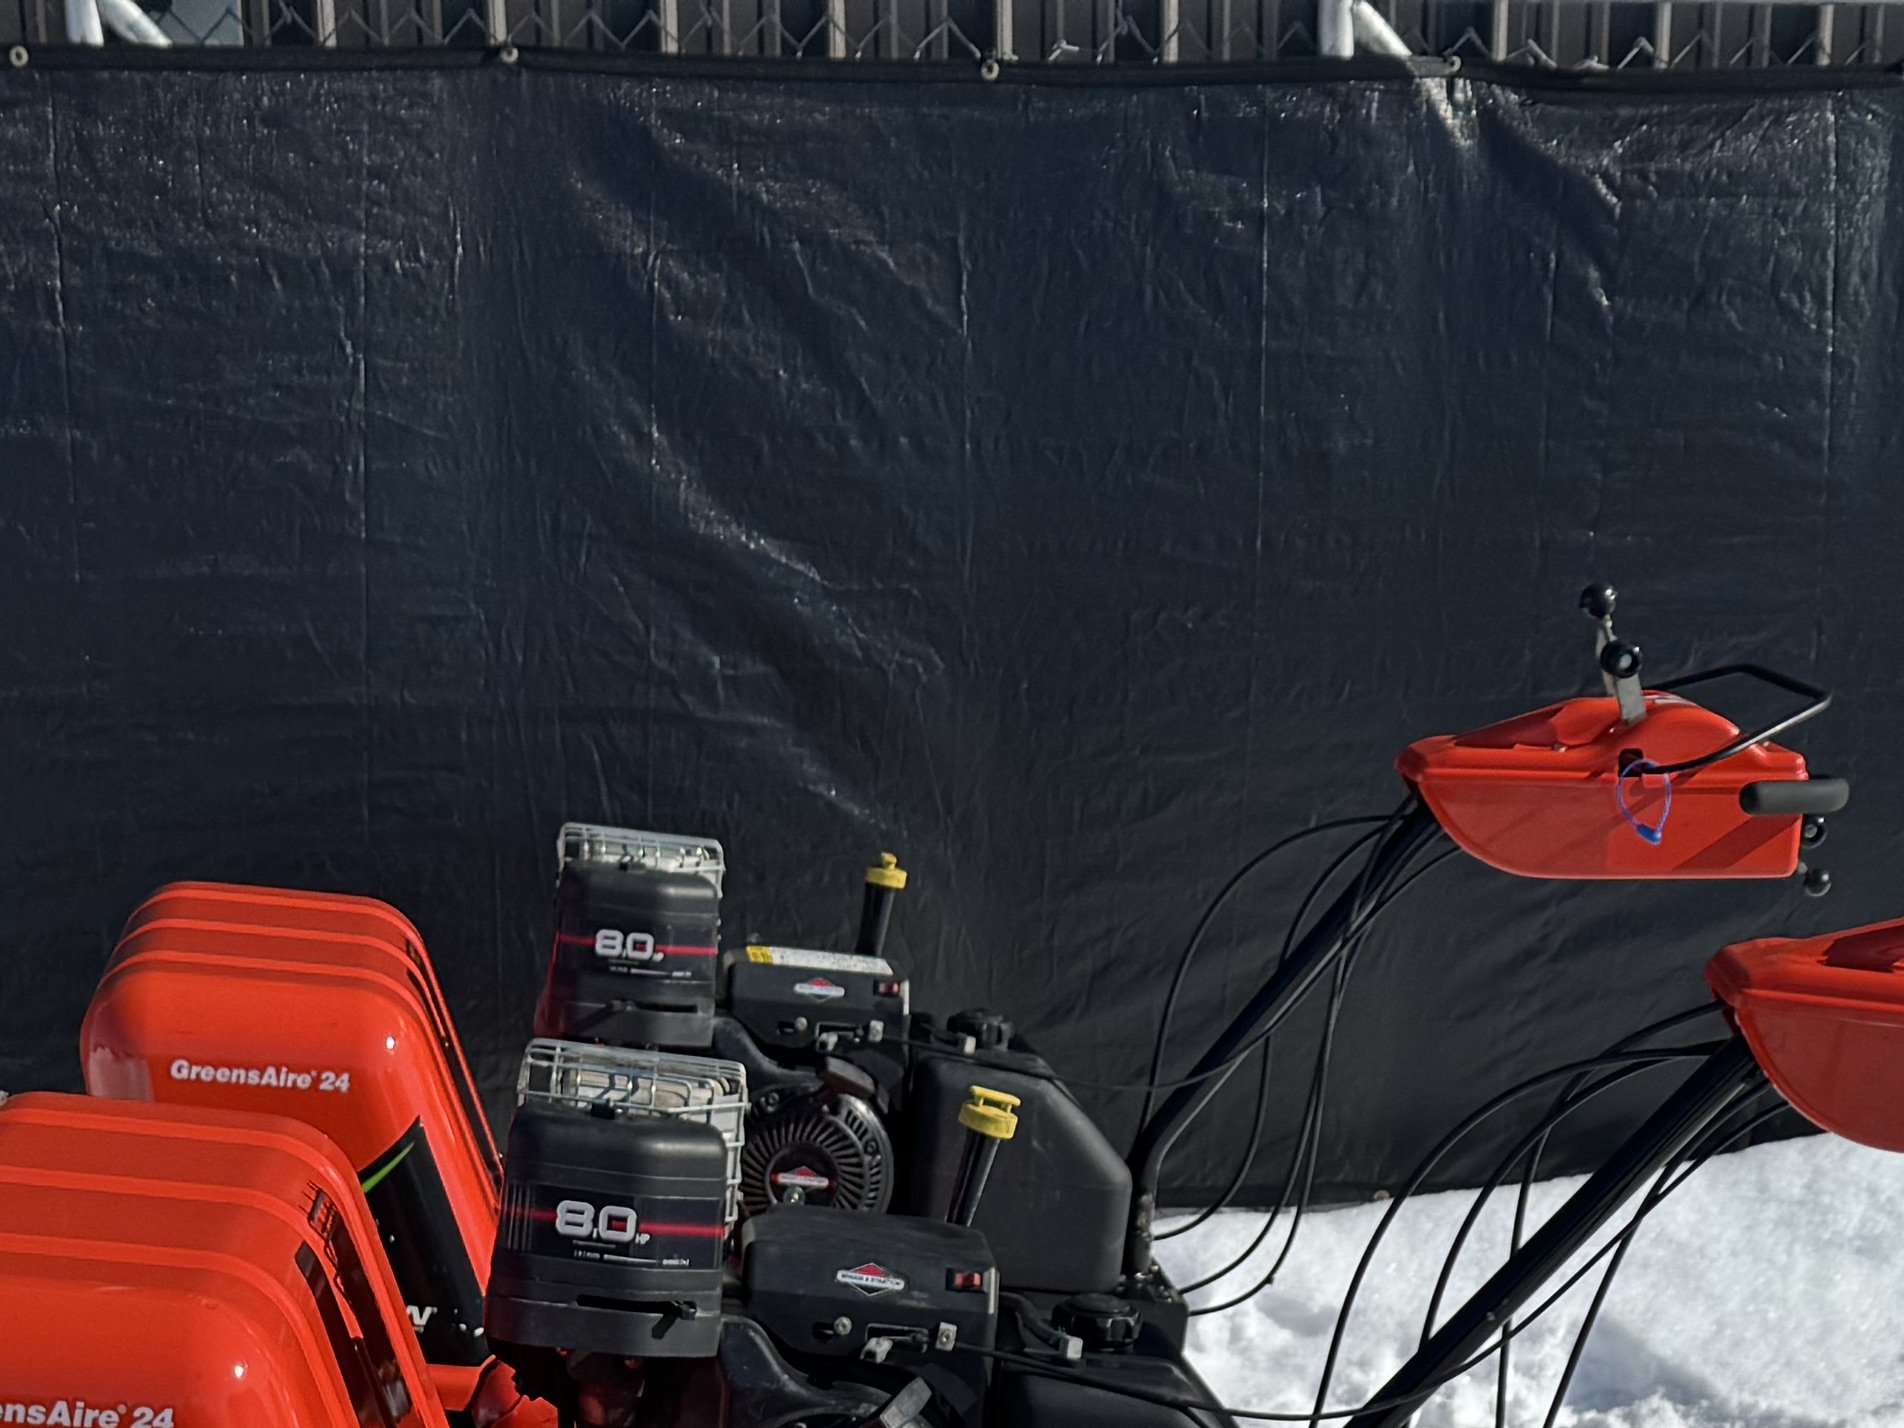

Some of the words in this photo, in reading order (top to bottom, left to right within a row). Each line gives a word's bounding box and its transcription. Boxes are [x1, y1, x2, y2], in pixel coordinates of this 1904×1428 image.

[170, 1058, 313, 1090] GreensAire
[319, 1071, 351, 1093] 24
[555, 1199, 638, 1243] 8.0
